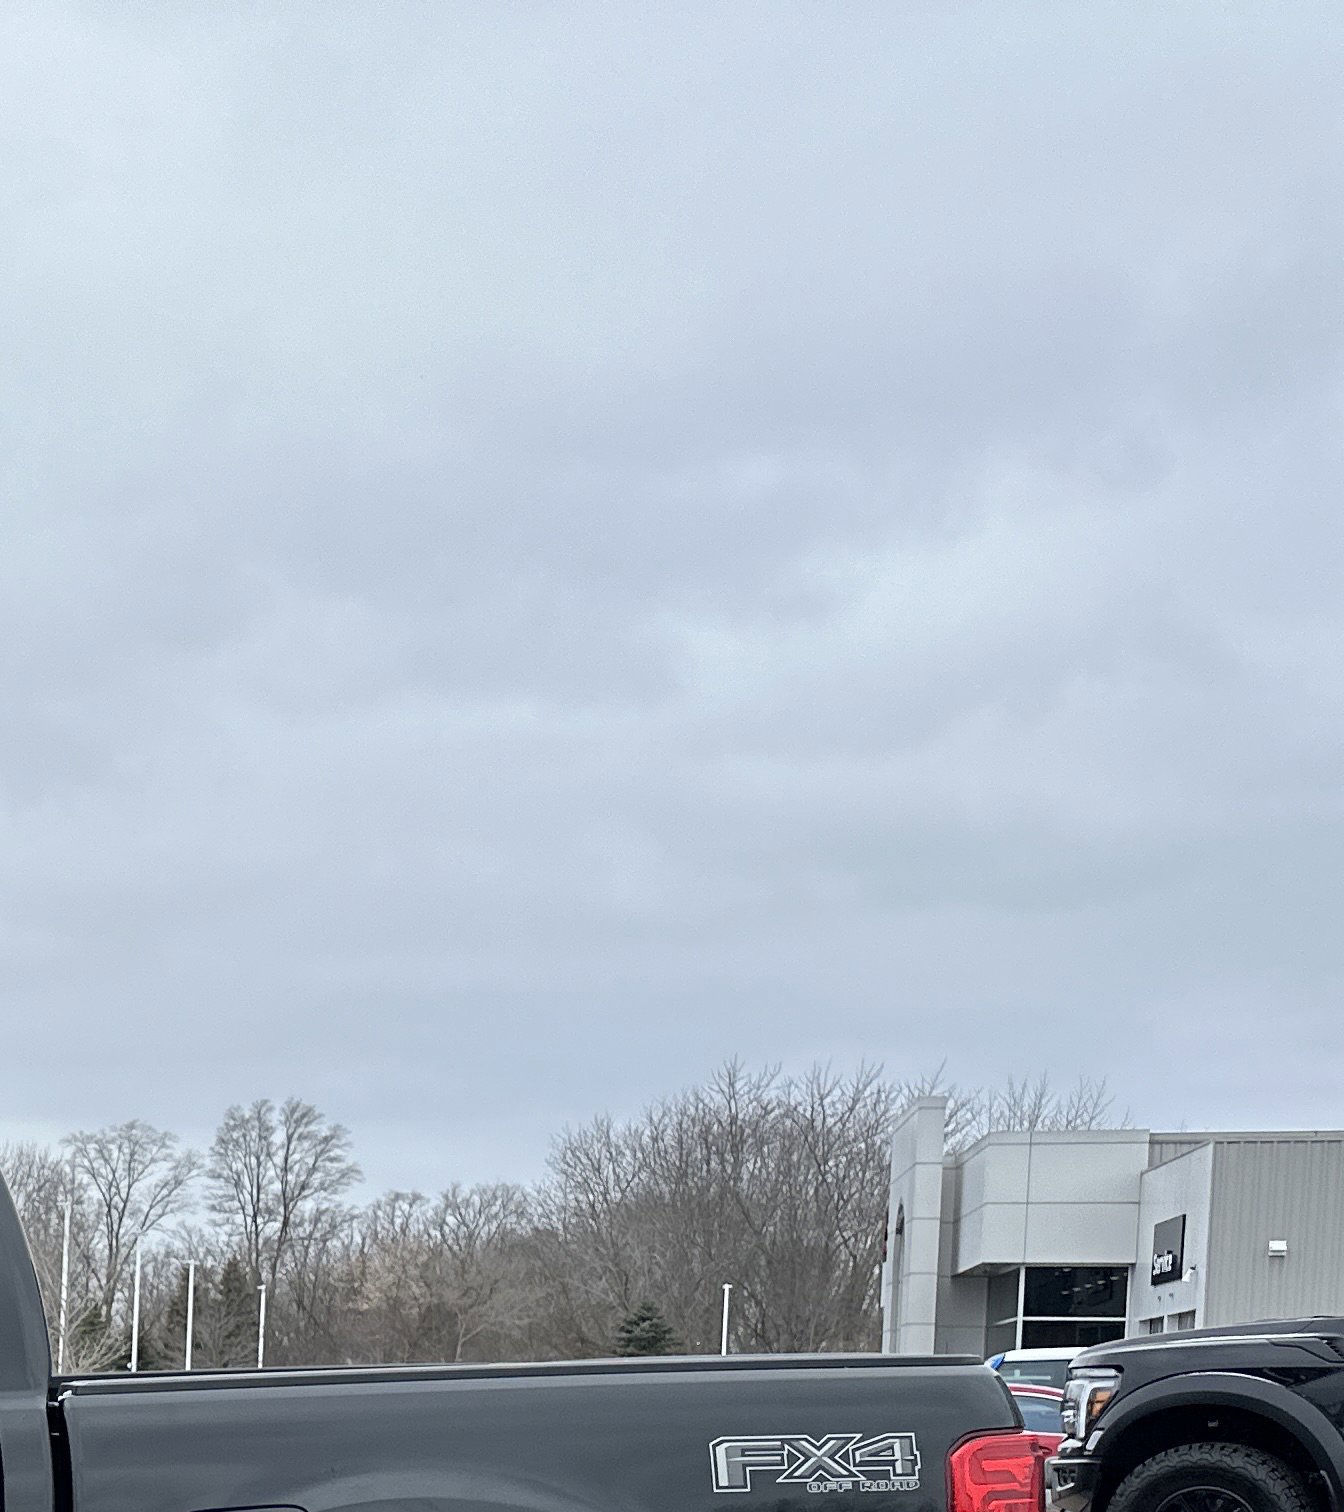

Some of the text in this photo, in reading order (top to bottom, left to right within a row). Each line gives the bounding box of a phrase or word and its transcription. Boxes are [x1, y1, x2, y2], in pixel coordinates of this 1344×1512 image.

[709, 1432, 921, 1492] FX4
[807, 1479, 920, 1493] OFF ROAD
